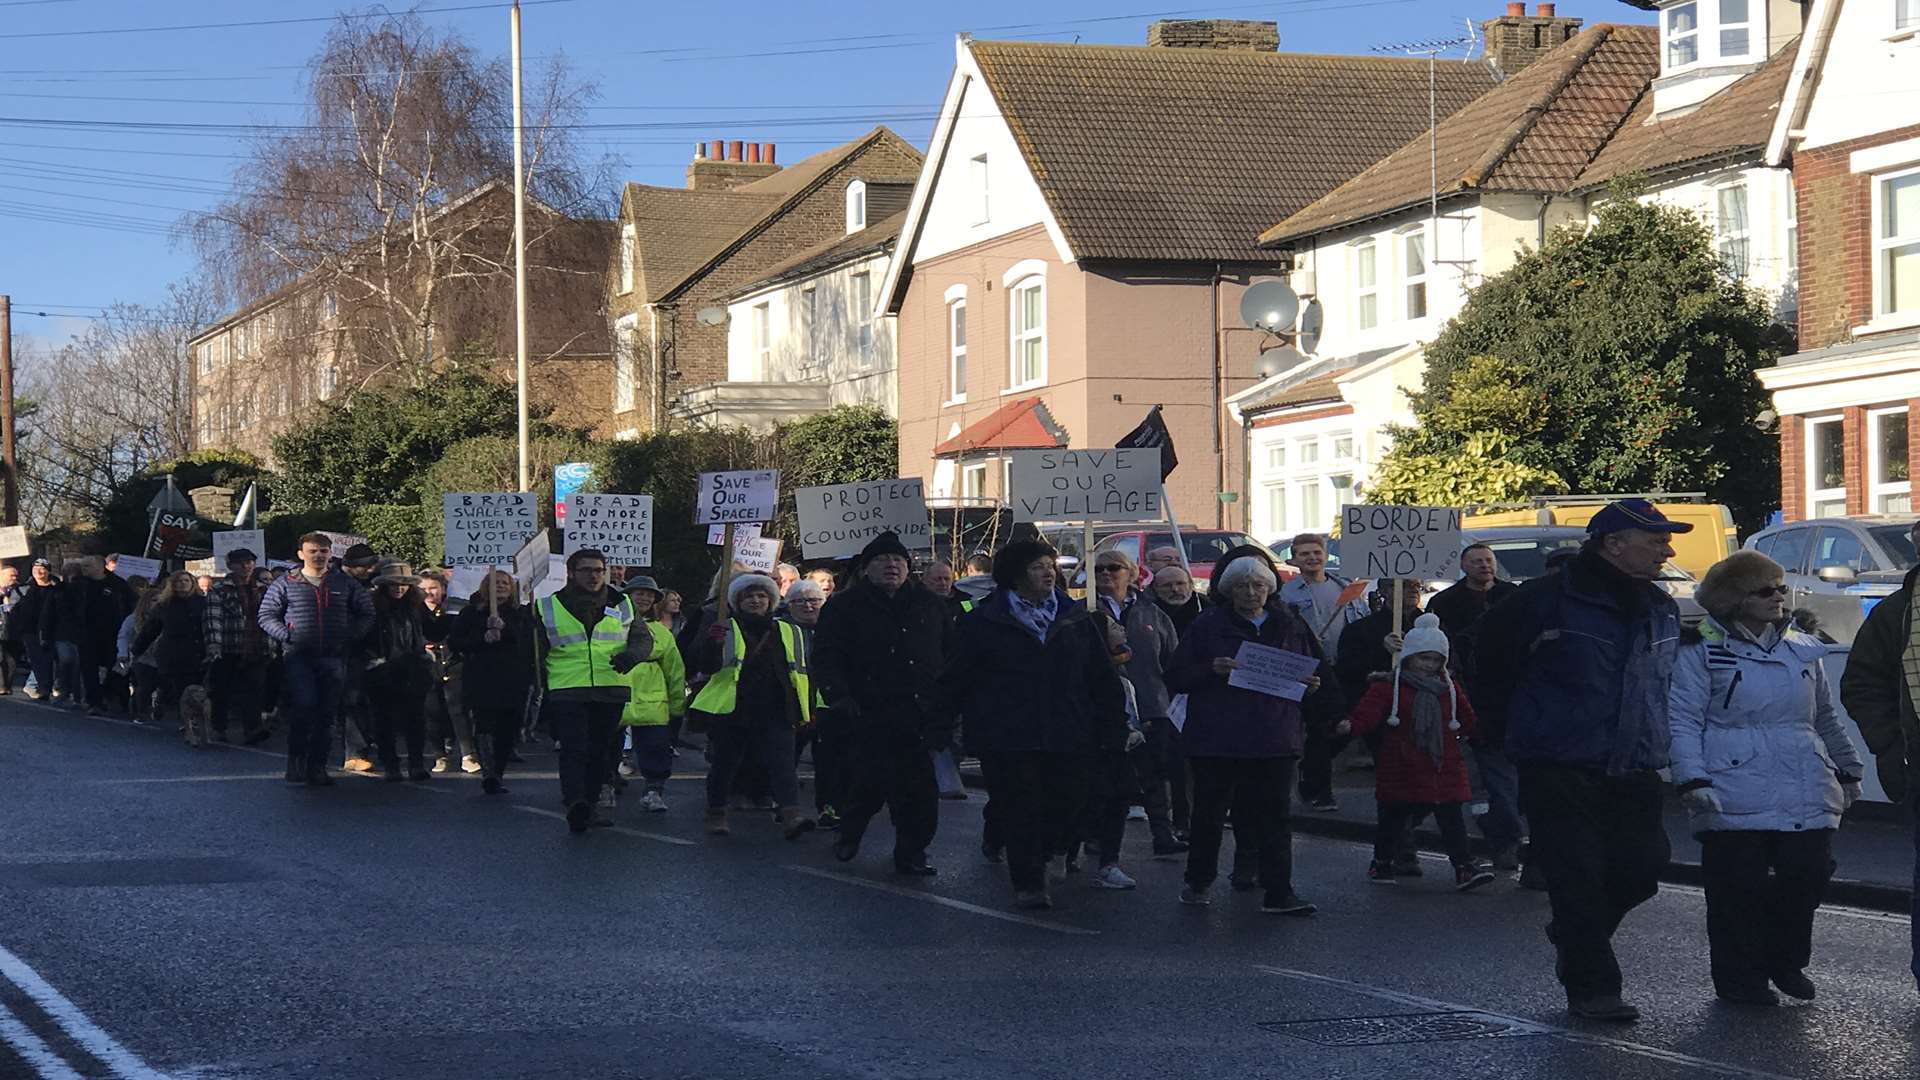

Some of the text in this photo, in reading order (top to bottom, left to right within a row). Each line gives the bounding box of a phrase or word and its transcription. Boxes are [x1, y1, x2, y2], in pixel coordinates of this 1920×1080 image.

[1041, 450, 1133, 470] SAVE
[712, 474, 751, 490] SAVE
[1052, 473, 1117, 491] OUR
[463, 495, 524, 506] BRAD
[575, 495, 641, 507] BRAD
[712, 490, 747, 505] OUR
[823, 484, 922, 510] PROTECT
[1021, 490, 1158, 516] VILLAGE
[453, 507, 529, 517] SWALE BC
[578, 509, 648, 519] NO MORE
[709, 505, 760, 521] SPACE!
[842, 507, 884, 522] OUR
[161, 513, 198, 530] SAY
[456, 520, 532, 529] LISTEN TO
[574, 520, 646, 530] TRAFFIC
[1348, 507, 1461, 535] BORDEN
[467, 531, 538, 541] VOTERS
[803, 523, 928, 545] COUNTRYSIDE
[1377, 533, 1426, 550] SAYS
[468, 544, 503, 554] NOT
[741, 549, 762, 558] OUR
[447, 555, 514, 565] DEVELOPE
[1368, 549, 1429, 577] NO!
